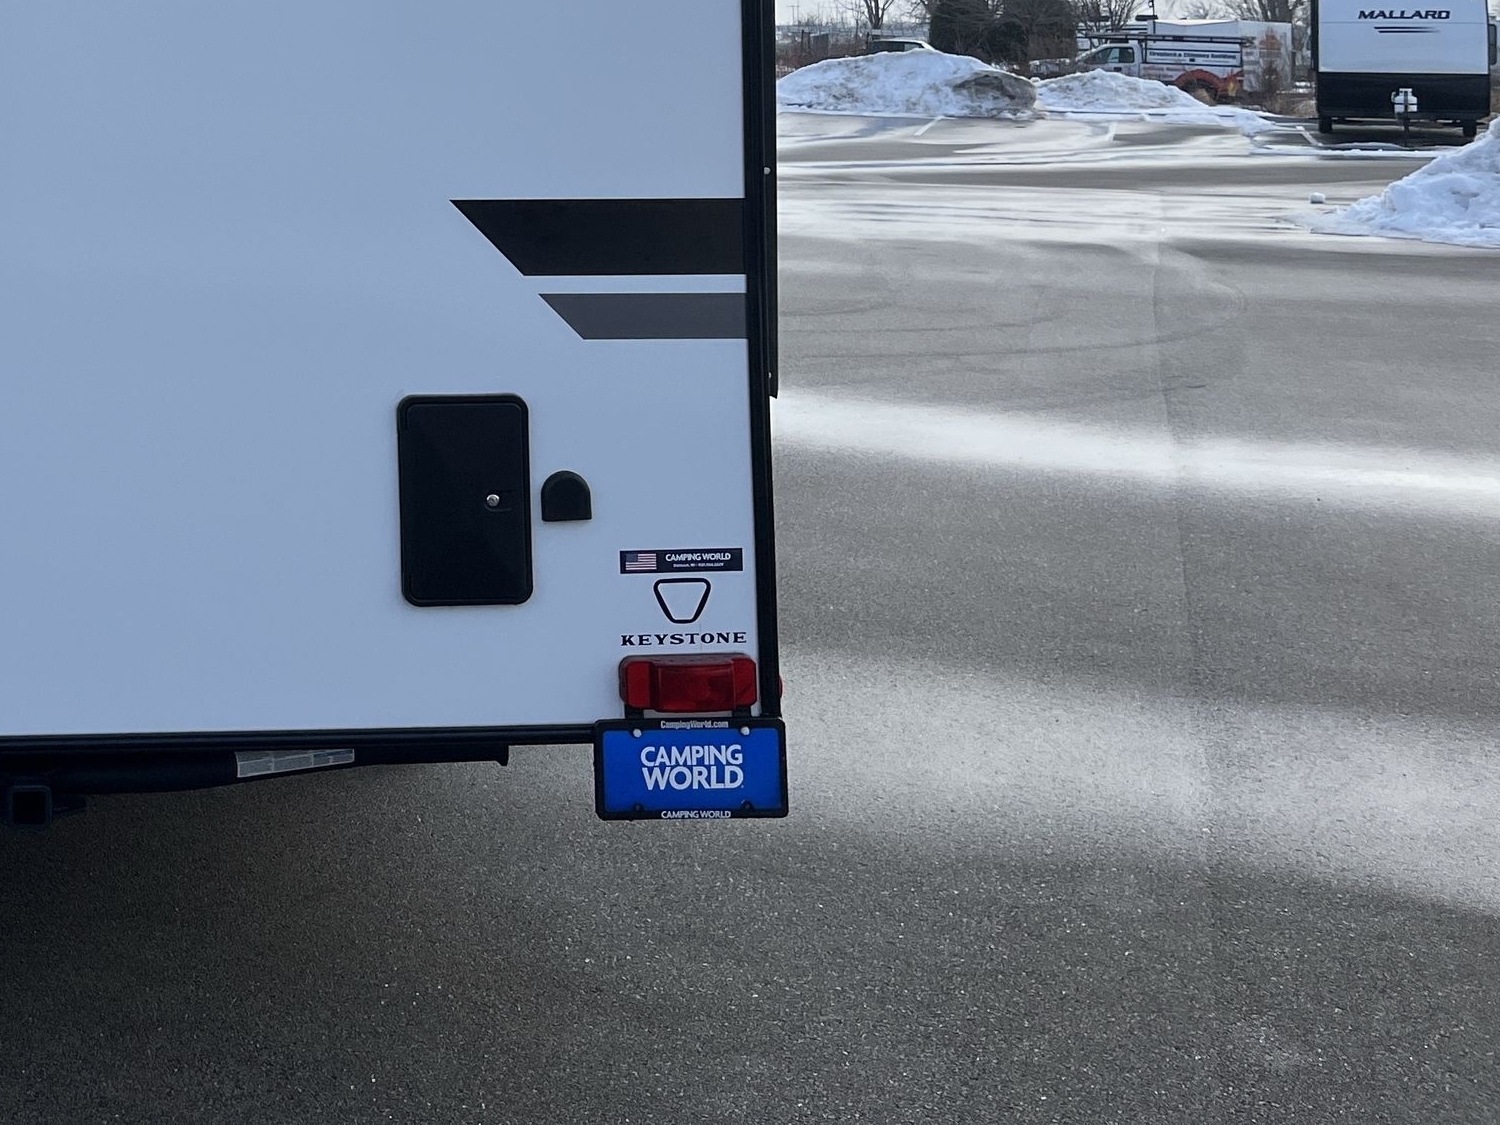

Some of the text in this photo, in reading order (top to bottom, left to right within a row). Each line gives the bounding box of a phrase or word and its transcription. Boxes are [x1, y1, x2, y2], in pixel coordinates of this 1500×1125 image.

[1358, 10, 1451, 20] MALLARD
[665, 552, 731, 562] CAMPING WORLD
[620, 632, 747, 646] KEYSTONE
[660, 720, 729, 729] CampingWorld.com
[640, 744, 743, 767] CAMPING
[641, 765, 744, 790] WORLD
[661, 810, 731, 819] CAMPING WORLD
